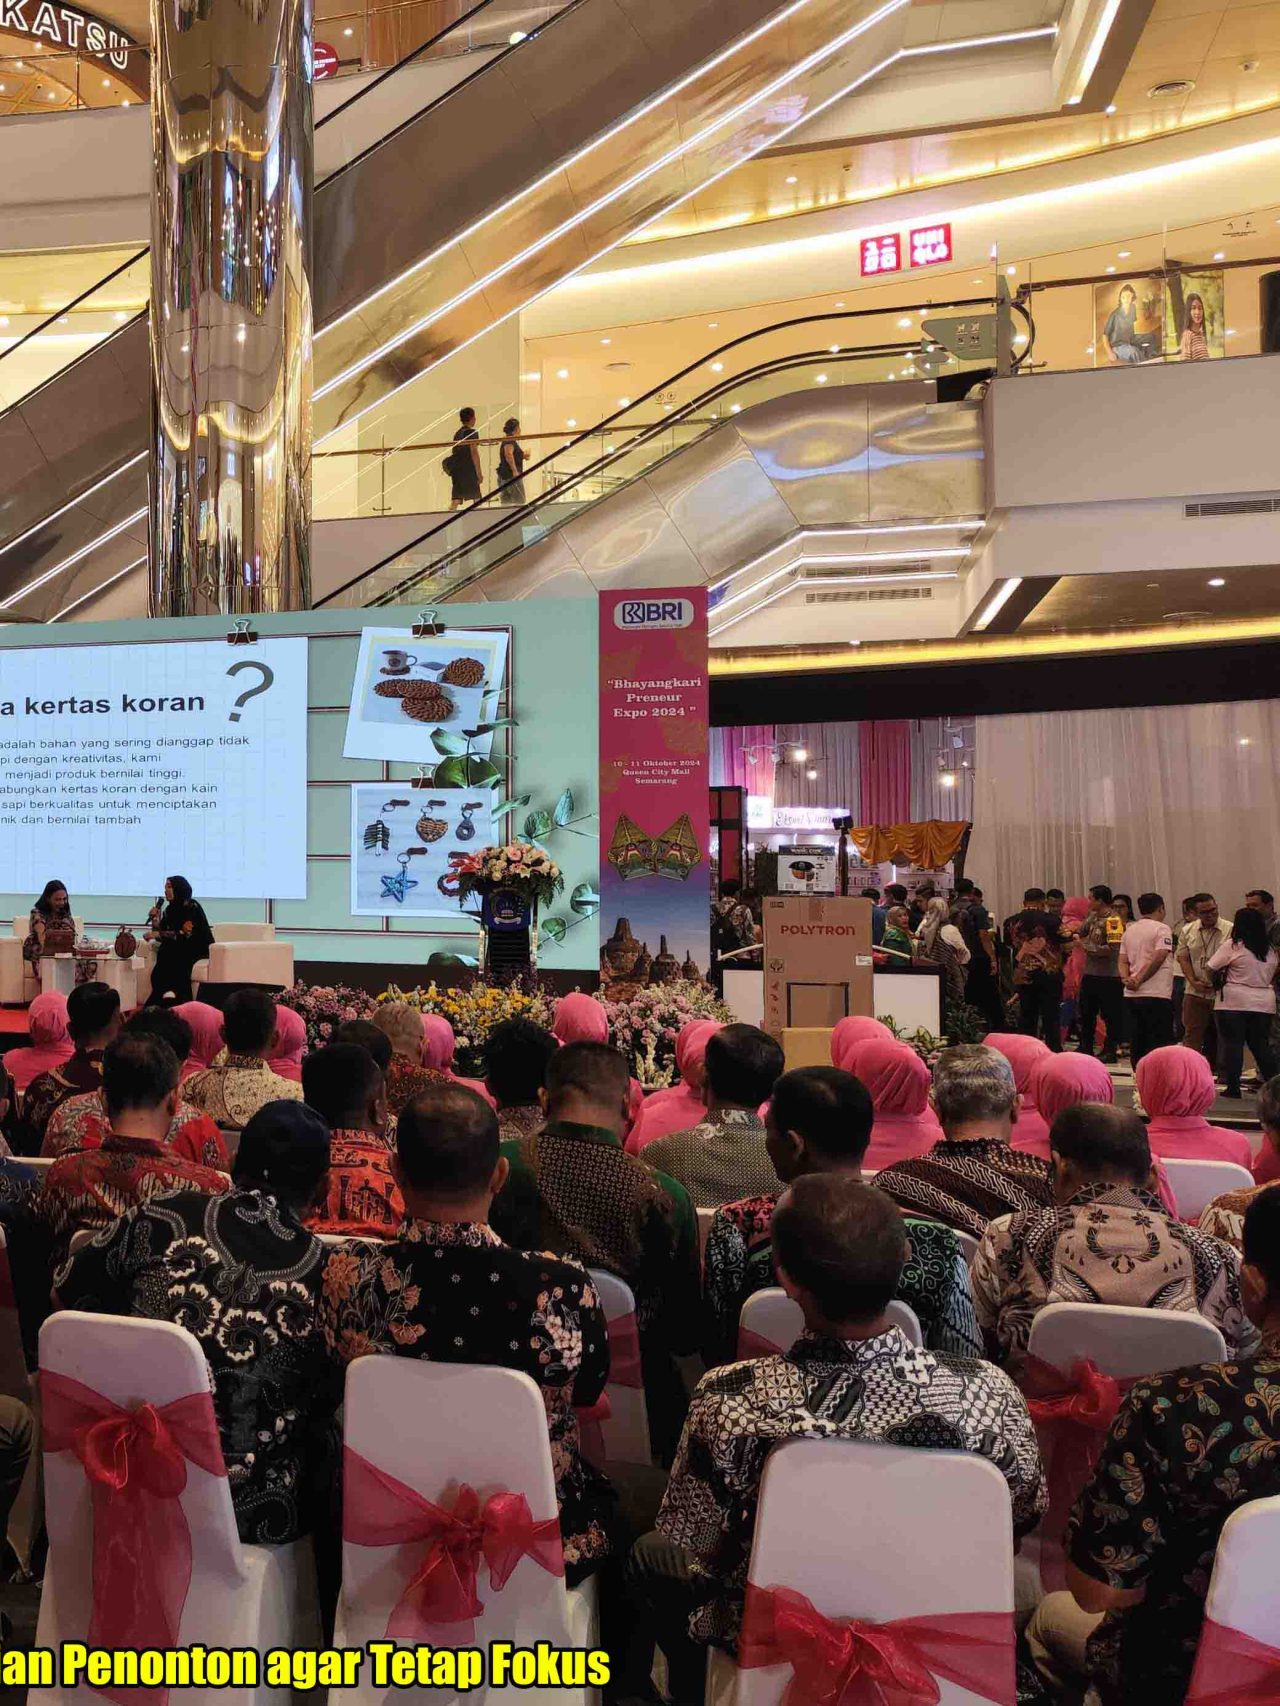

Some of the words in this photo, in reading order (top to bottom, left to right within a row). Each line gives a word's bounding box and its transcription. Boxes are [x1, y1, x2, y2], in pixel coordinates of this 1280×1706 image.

[646, 602, 683, 622] BRI
[25, 696, 111, 715] kertas
[122, 694, 205, 713] koran
[224, 660, 275, 723] ?
[626, 693, 683, 704] Preneur
[613, 707, 648, 720] Expo
[651, 706, 686, 717] 2024
[40, 739, 77, 749] bahan
[81, 740, 110, 751] yang
[114, 737, 151, 749] sering
[156, 736, 214, 748] dianggap
[219, 736, 250, 746] tidak
[14, 755, 58, 765] dengan
[62, 753, 126, 764] kreativitas,
[131, 753, 161, 762] kami
[5, 770, 52, 781] menjadi
[55, 769, 96, 780] produk
[100, 768, 144, 778] bernilai
[149, 768, 185, 779] tinggi.
[651, 768, 670, 777] City
[635, 777, 679, 785] Semarang
[61, 784, 98, 793] kertas
[102, 783, 137, 793] koran
[140, 783, 187, 795] dengan
[191, 783, 218, 793] kain
[1, 800, 26, 811] sapi
[29, 799, 94, 809] berkualitas
[98, 799, 132, 809] untuk
[136, 798, 217, 811] menciptakan
[21, 815, 44, 825] dan
[48, 815, 90, 825] bernilai
[94, 815, 142, 825] tambah
